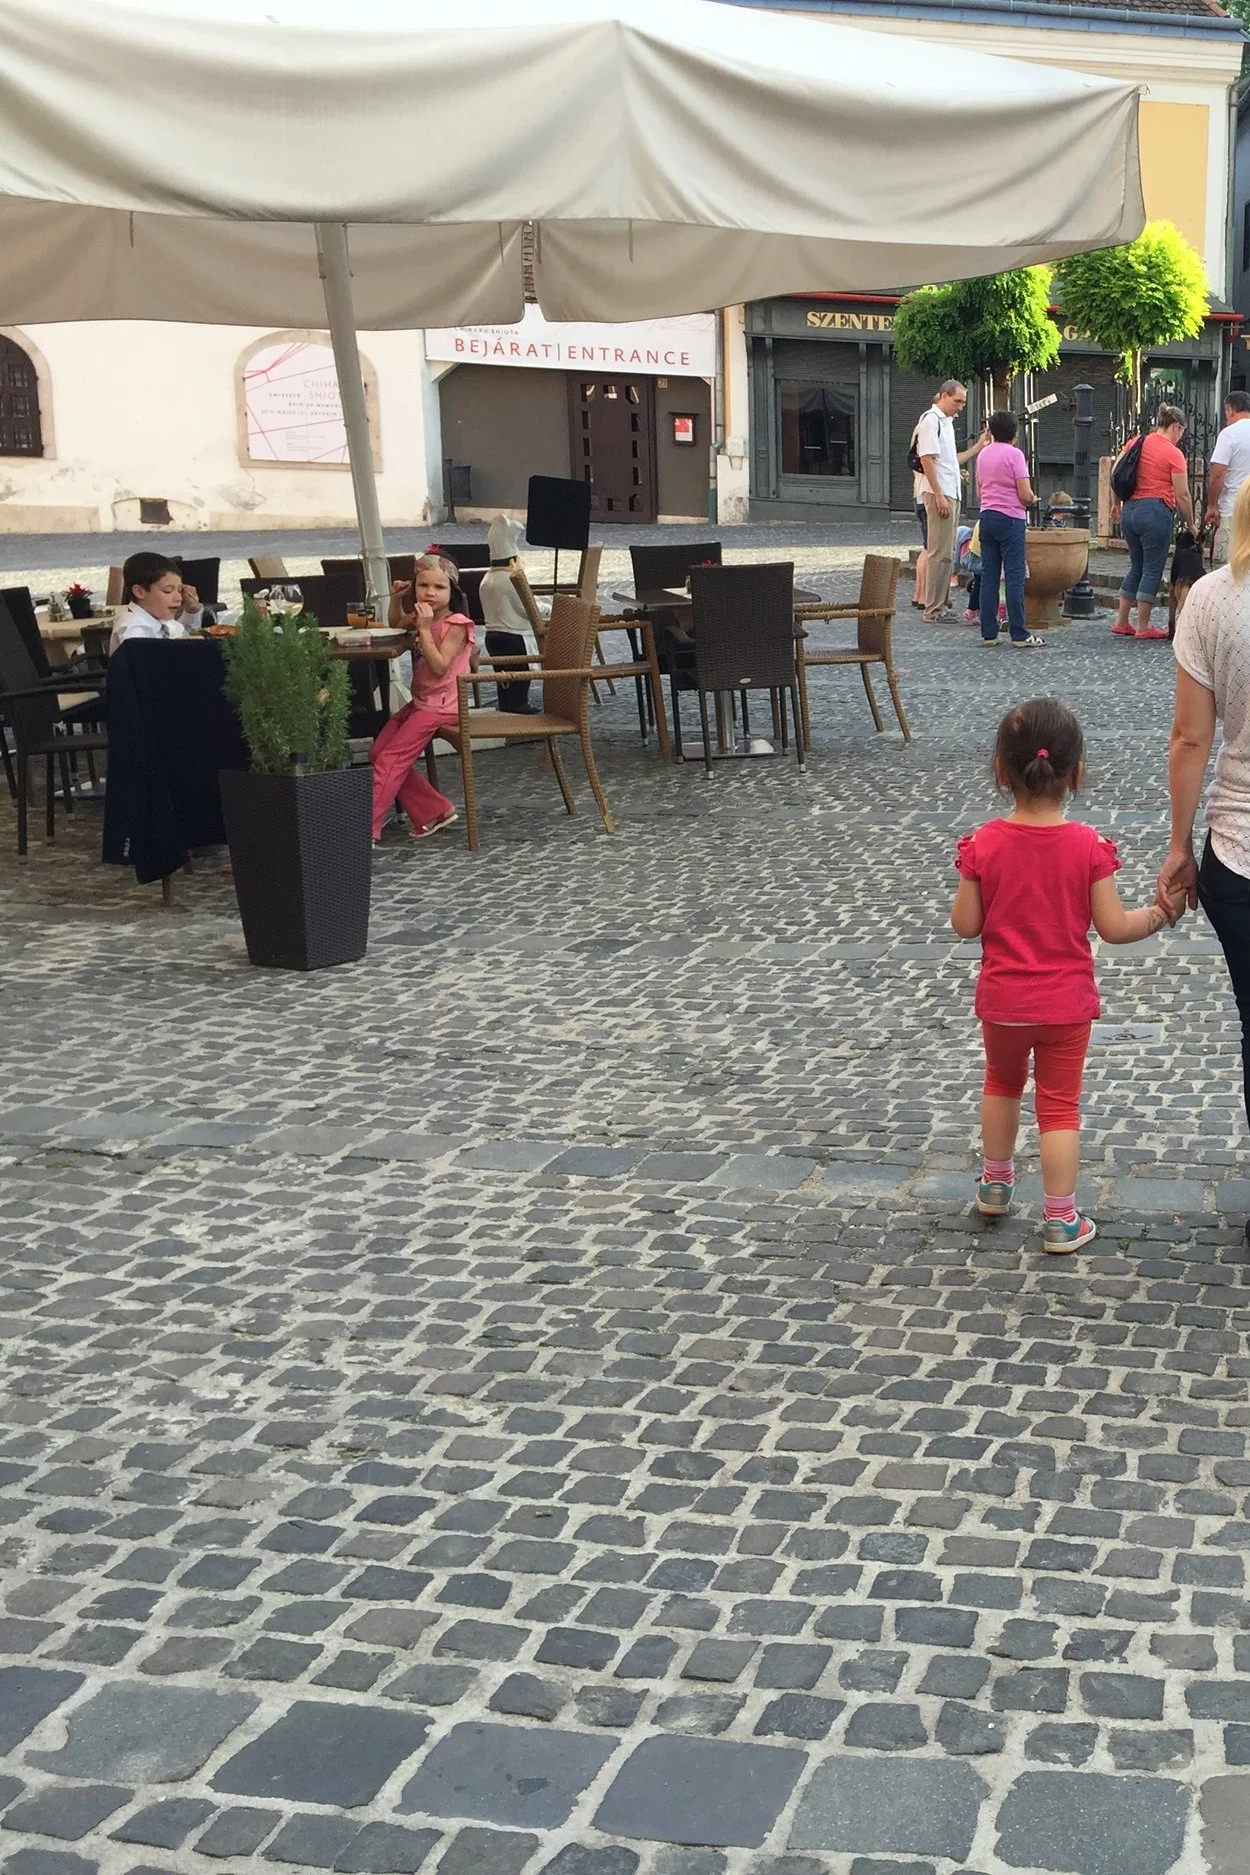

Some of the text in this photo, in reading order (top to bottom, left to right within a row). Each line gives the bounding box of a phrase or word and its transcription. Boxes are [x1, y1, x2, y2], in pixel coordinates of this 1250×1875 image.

[806, 311, 896, 331] SZENTE
[455, 337, 690, 365] BEJÁRAT ENTRANCE
[303, 380, 340, 389] CHIHA
[308, 391, 337, 400] SHIO
